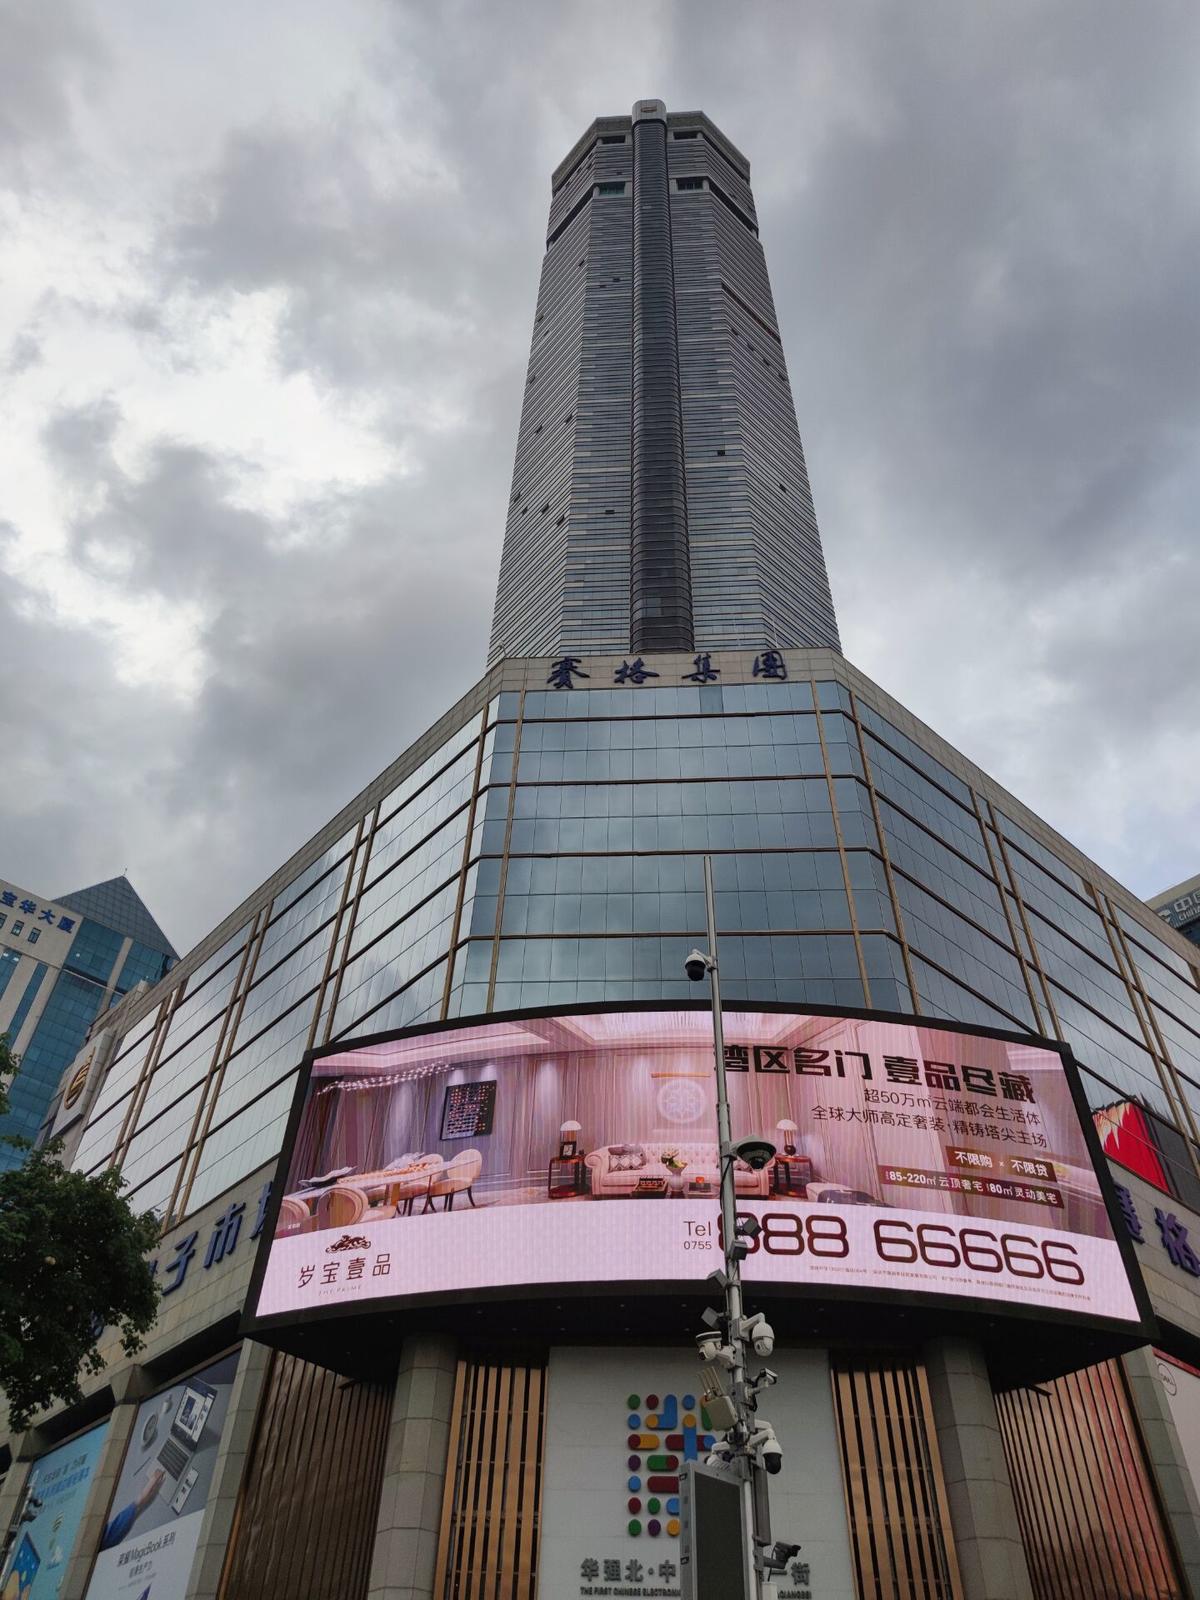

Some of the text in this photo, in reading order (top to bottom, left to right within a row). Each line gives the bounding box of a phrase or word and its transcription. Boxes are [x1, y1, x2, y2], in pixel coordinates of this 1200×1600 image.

[955, 1150, 1049, 1178] 不限购 不限贷
[683, 1220, 712, 1236] Tel
[683, 1241, 712, 1250] 0755
[873, 1219, 1085, 1286] 66666
[297, 1253, 391, 1289] 岁宝壹品
